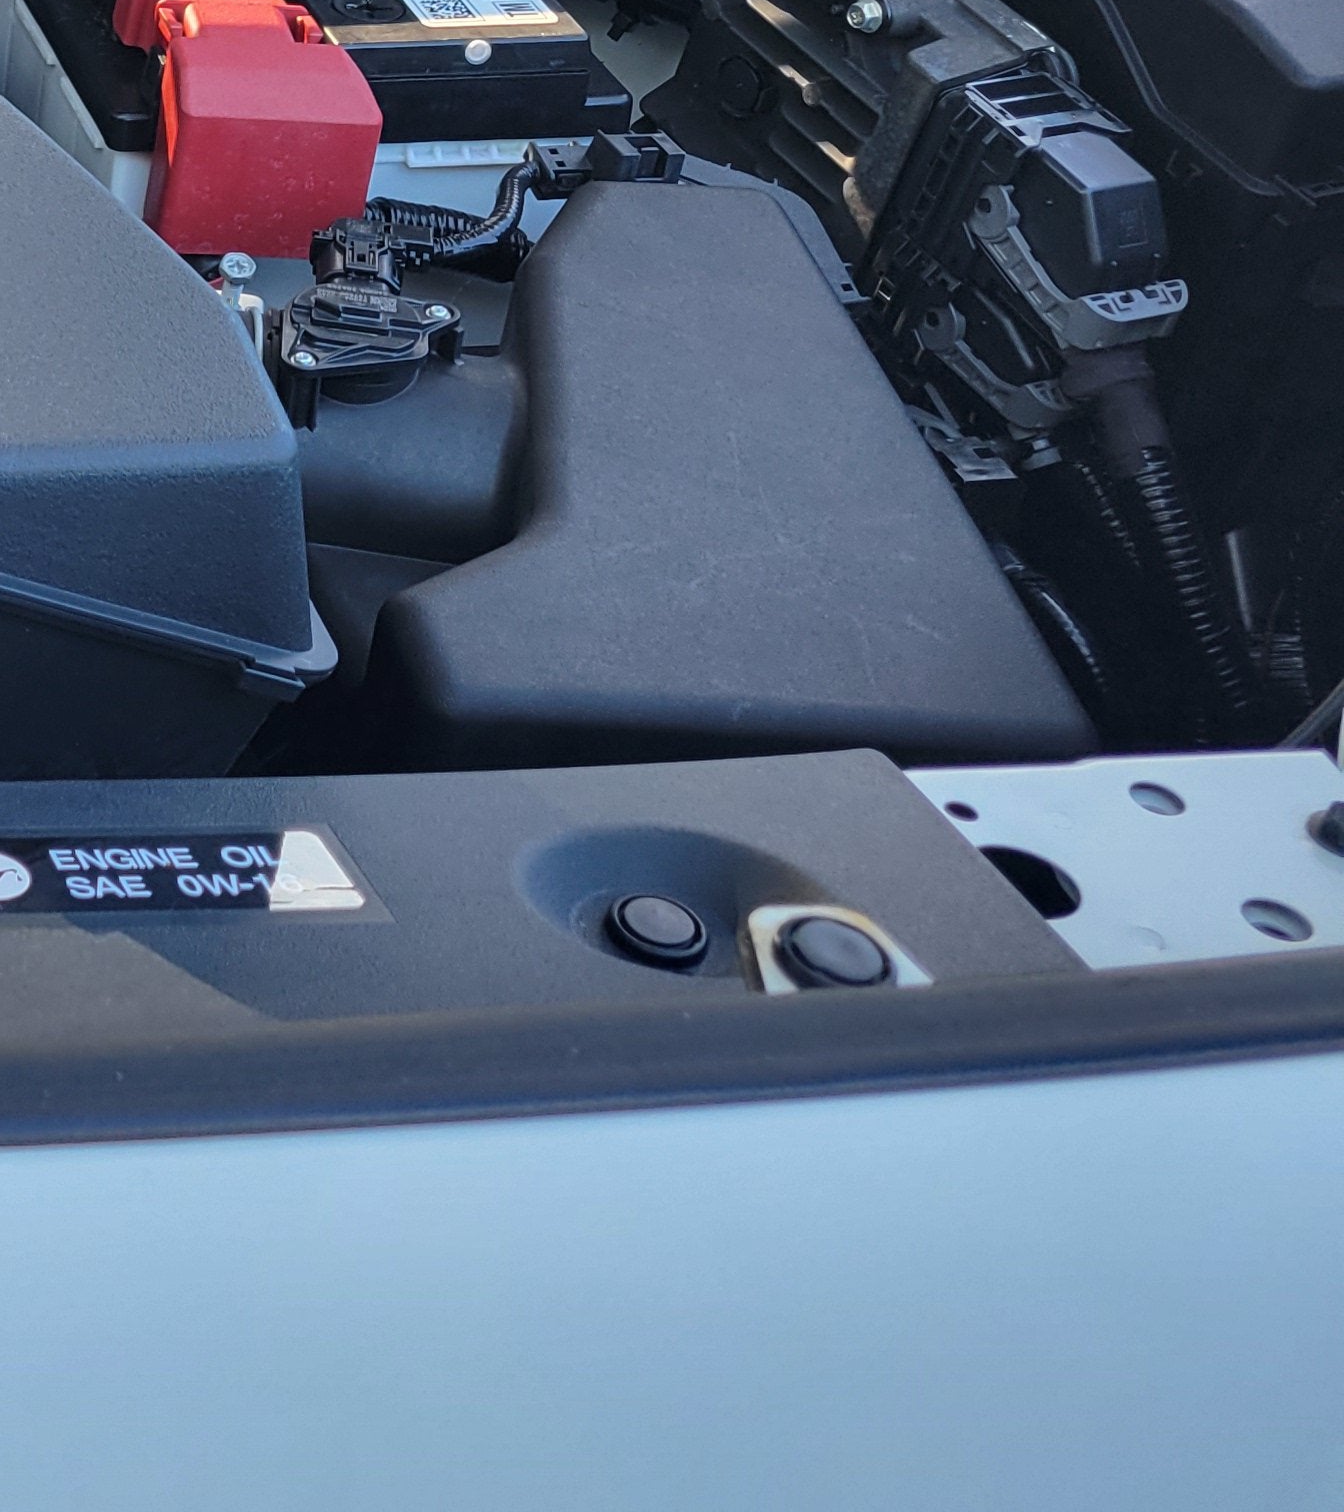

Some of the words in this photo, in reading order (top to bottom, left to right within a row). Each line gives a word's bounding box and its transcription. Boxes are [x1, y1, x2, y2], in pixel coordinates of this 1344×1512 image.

[48, 846, 199, 872] ENGINE
[220, 845, 286, 868] OIL
[65, 875, 153, 900] SAE
